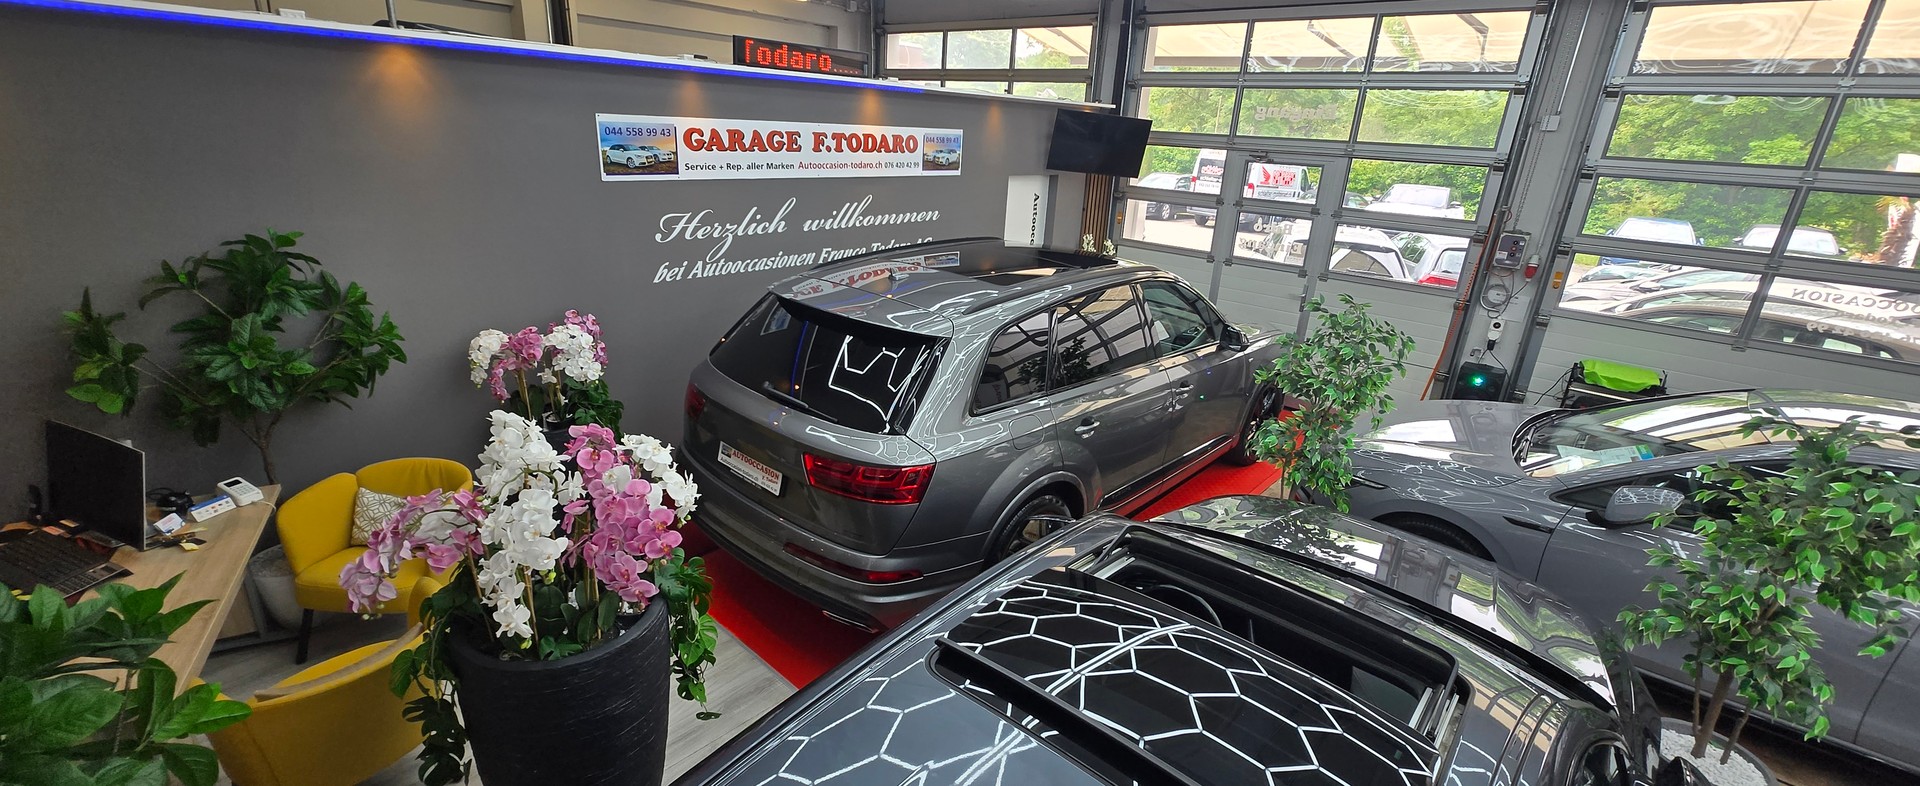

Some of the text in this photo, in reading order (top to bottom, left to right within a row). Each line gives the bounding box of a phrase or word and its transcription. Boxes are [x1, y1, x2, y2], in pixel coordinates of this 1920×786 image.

[604, 126, 671, 137] 044 558 99 43
[682, 127, 919, 154] GARAGE F.TODARO
[935, 136, 946, 144] 558
[684, 162, 717, 171] Service
[726, 163, 744, 173] Rep.
[746, 162, 764, 171] aller
[766, 162, 795, 171] Marken
[797, 161, 883, 170] Autooccasion-todaro.ch
[884, 161, 895, 169] 076
[895, 161, 905, 169] 420
[905, 161, 912, 169] 42
[912, 161, 920, 169] 99
[654, 194, 941, 263] Herzlich willkommen
[653, 261, 688, 284] bei
[688, 248, 815, 280] Autooccasionen
[732, 450, 780, 480] AUTOOCCASION
